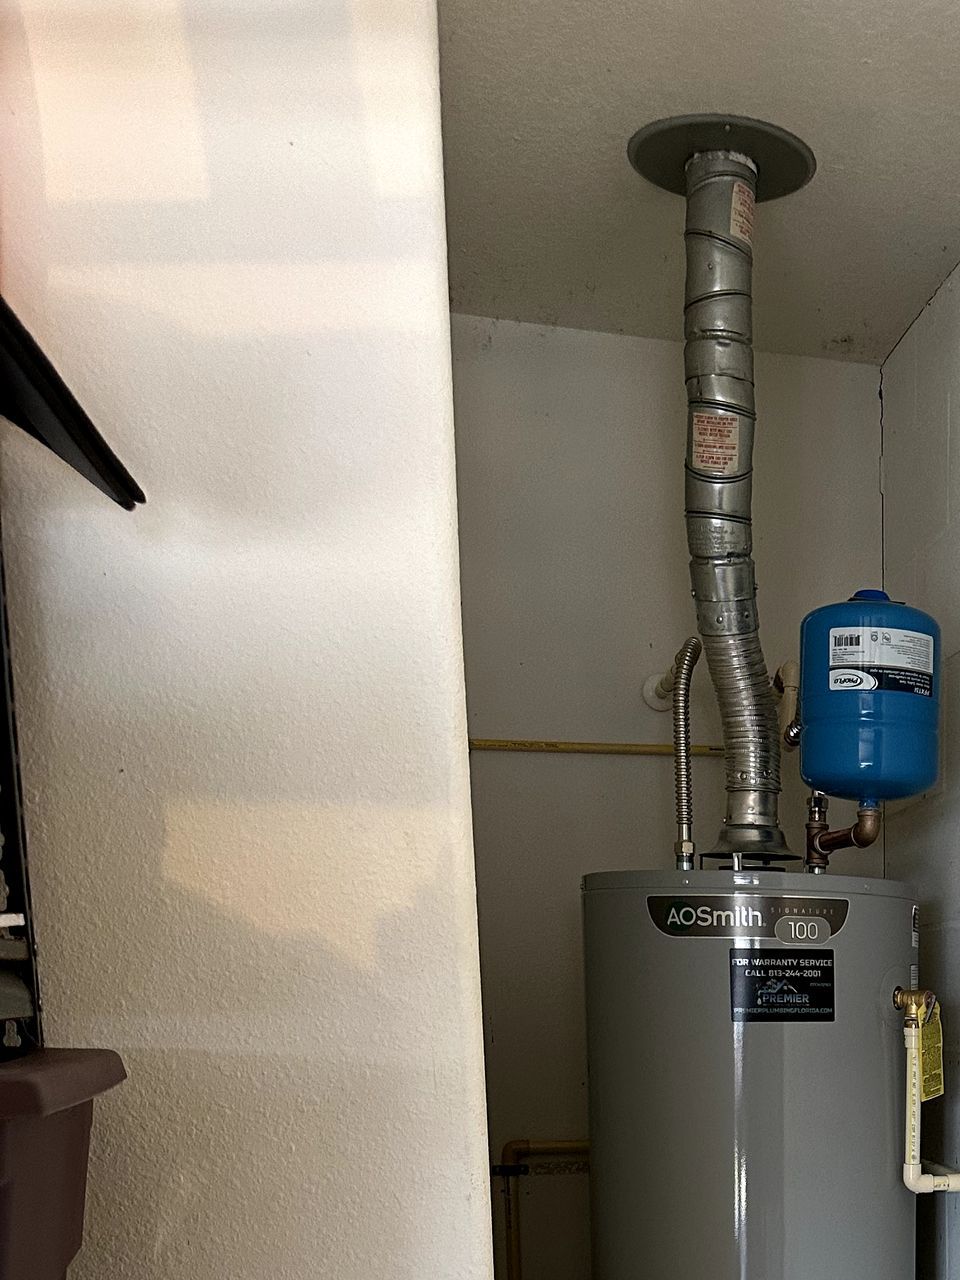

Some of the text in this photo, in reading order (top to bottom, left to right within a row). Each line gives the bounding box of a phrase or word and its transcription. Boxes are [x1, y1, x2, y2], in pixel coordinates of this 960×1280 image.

[667, 905, 764, 927] AOSmith
[788, 921, 819, 939] 100
[731, 958, 833, 967] FOR WARRANTY SERVICE
[745, 969, 821, 977] CALL 813-244-2001
[762, 993, 810, 1003] PREMIER
